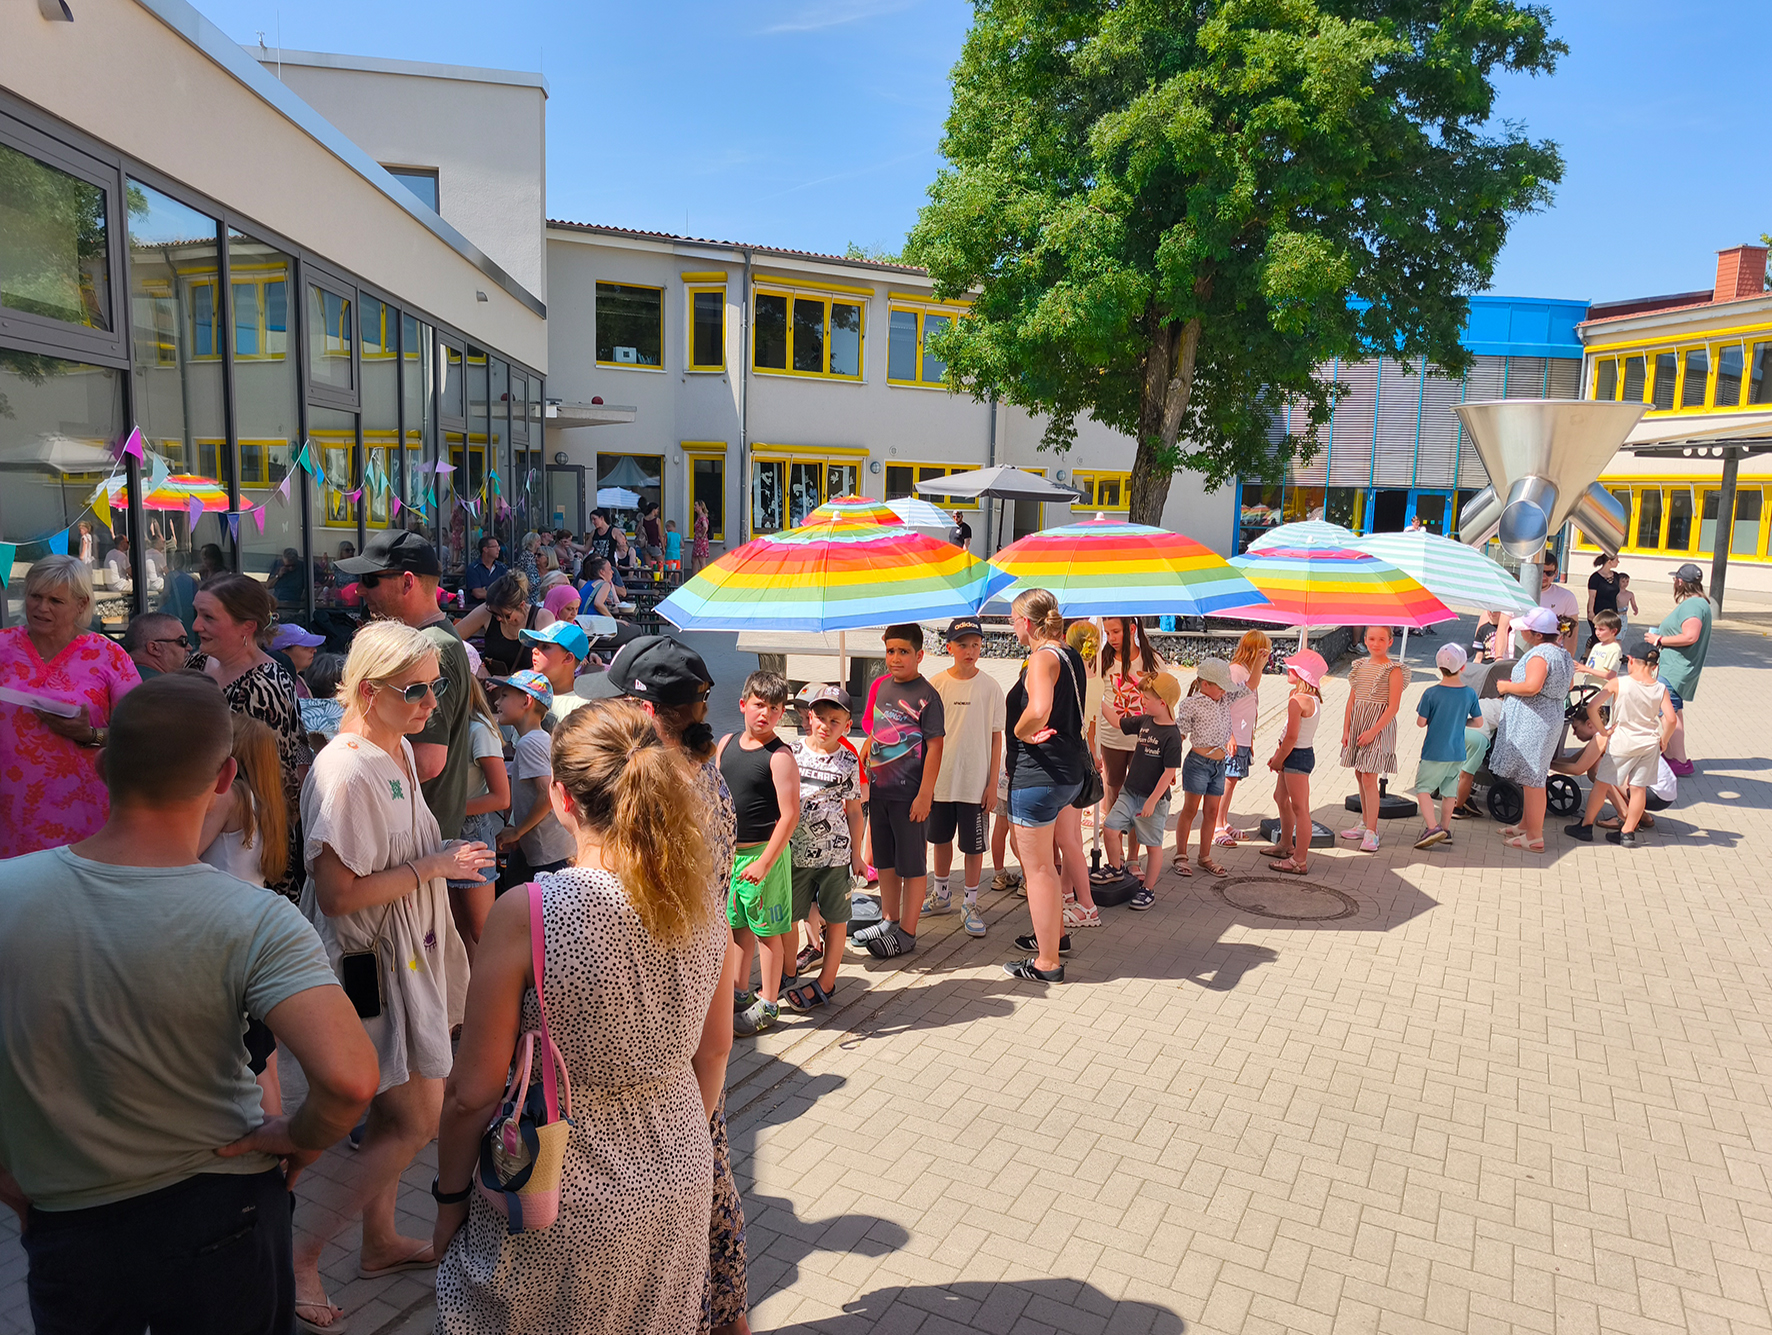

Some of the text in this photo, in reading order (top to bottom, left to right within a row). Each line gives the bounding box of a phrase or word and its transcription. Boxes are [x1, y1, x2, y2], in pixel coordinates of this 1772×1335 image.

[1147, 735, 1159, 745] this
[798, 766, 842, 784] NECRAFT
[769, 904, 783, 924] 10
